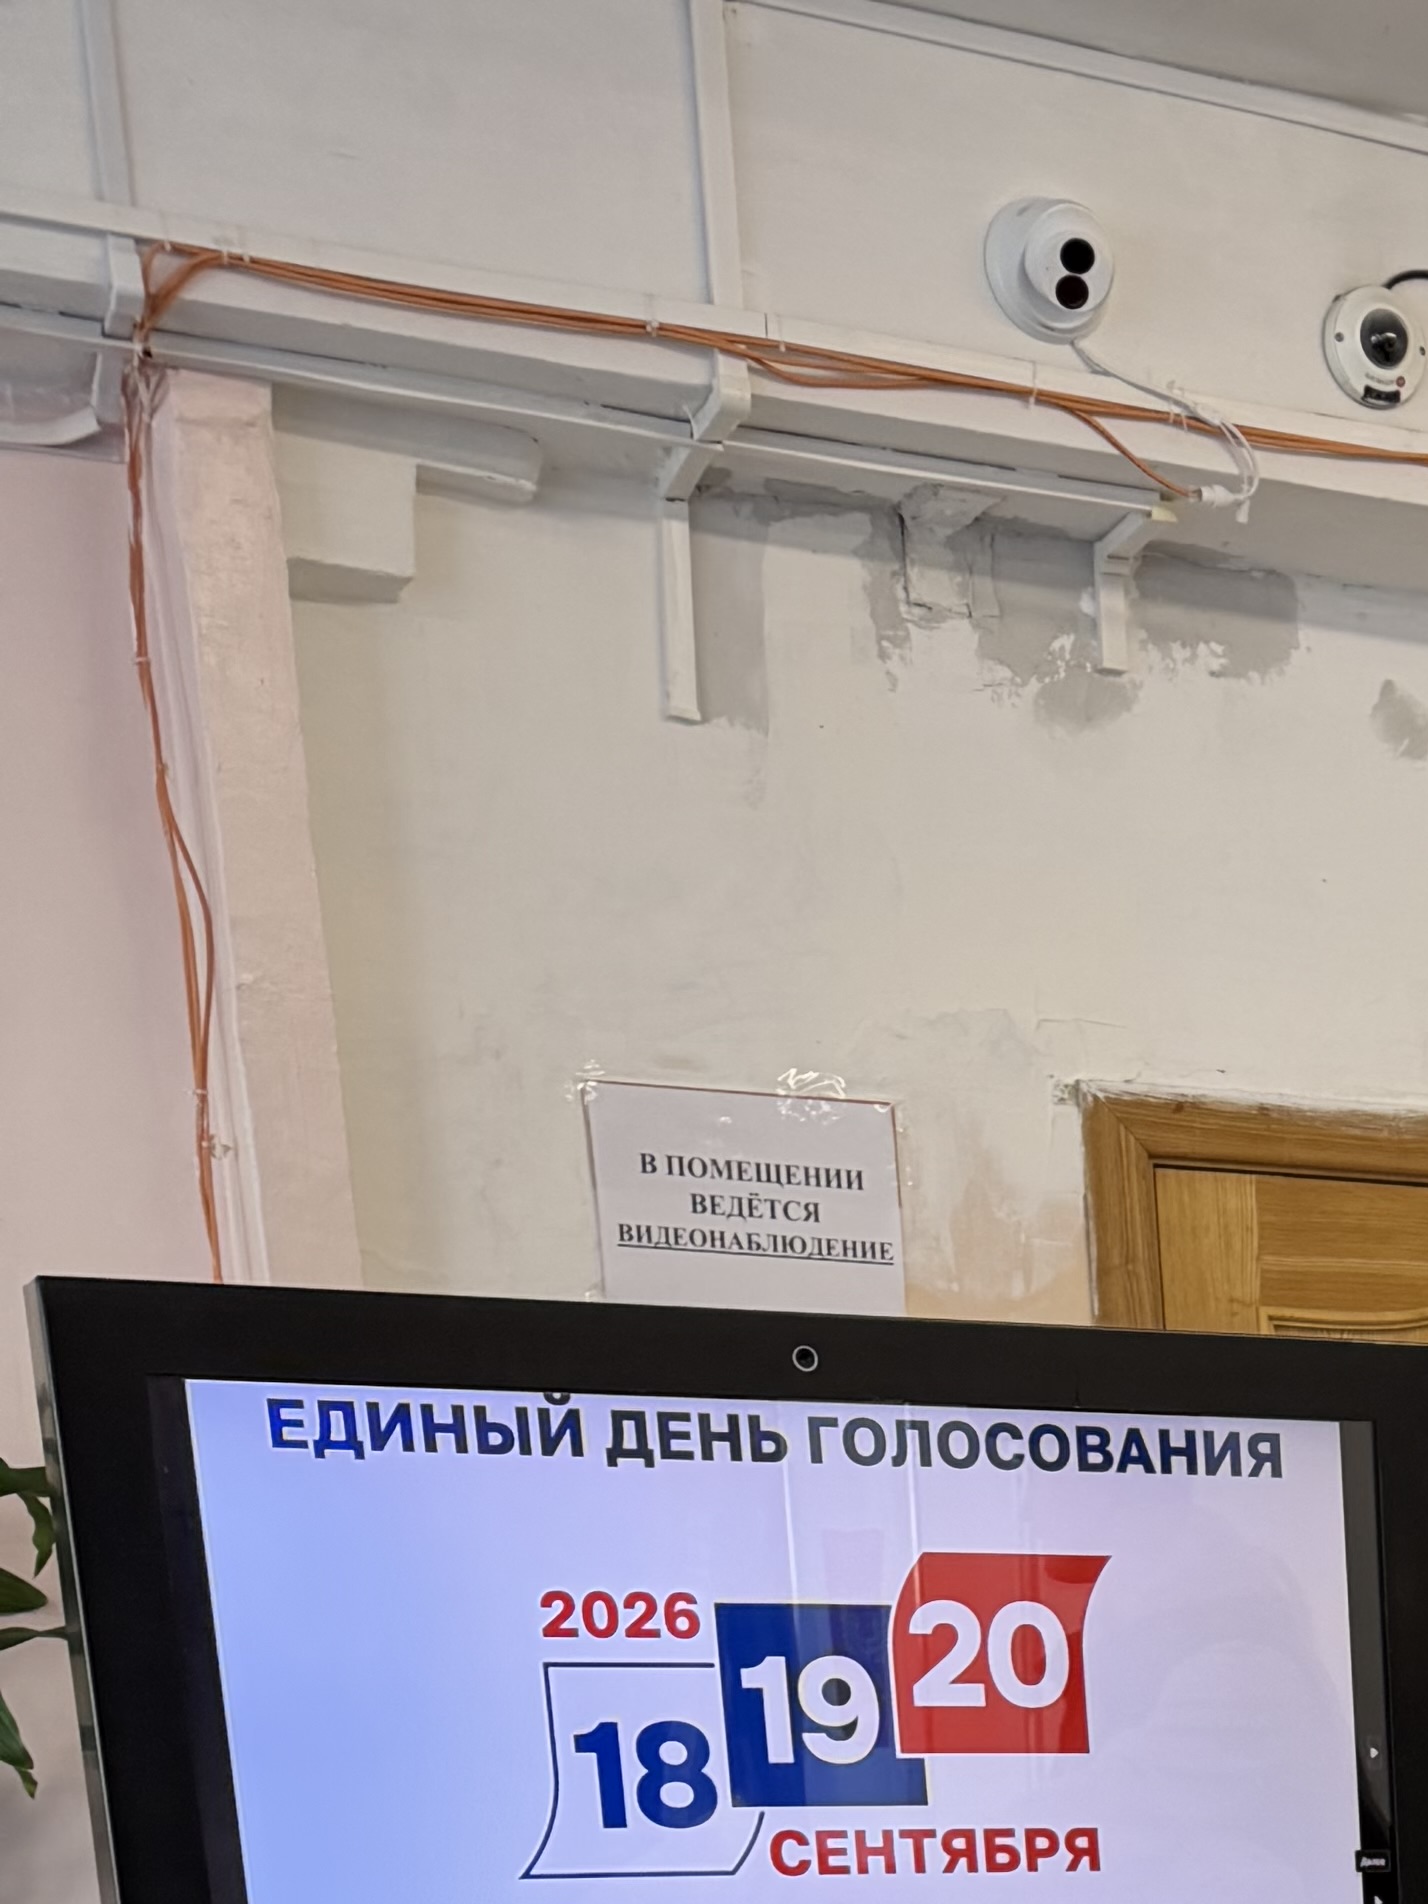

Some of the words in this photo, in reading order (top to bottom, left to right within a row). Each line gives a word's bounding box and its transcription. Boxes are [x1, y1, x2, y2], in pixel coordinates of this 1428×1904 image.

[639, 1153, 658, 1174] В
[665, 1154, 864, 1190] ПОМЕЩЕНИИ
[690, 1192, 821, 1223] ВЕДЁТСЯ
[617, 1223, 895, 1261] ВИДЕОНАБЛЮДЕНИЕ
[266, 1392, 584, 1460] ЕДИНЫЙ
[605, 1408, 788, 1468] ДЕНЬ
[807, 1416, 1283, 1478] ГОЛОСОВАНИЯ
[540, 1591, 700, 1639] 2026
[908, 1599, 1069, 1709] 20
[740, 1655, 880, 1765] 19
[573, 1720, 718, 1829] 18
[769, 1827, 1101, 1877] СЕНТЯБРЯ
